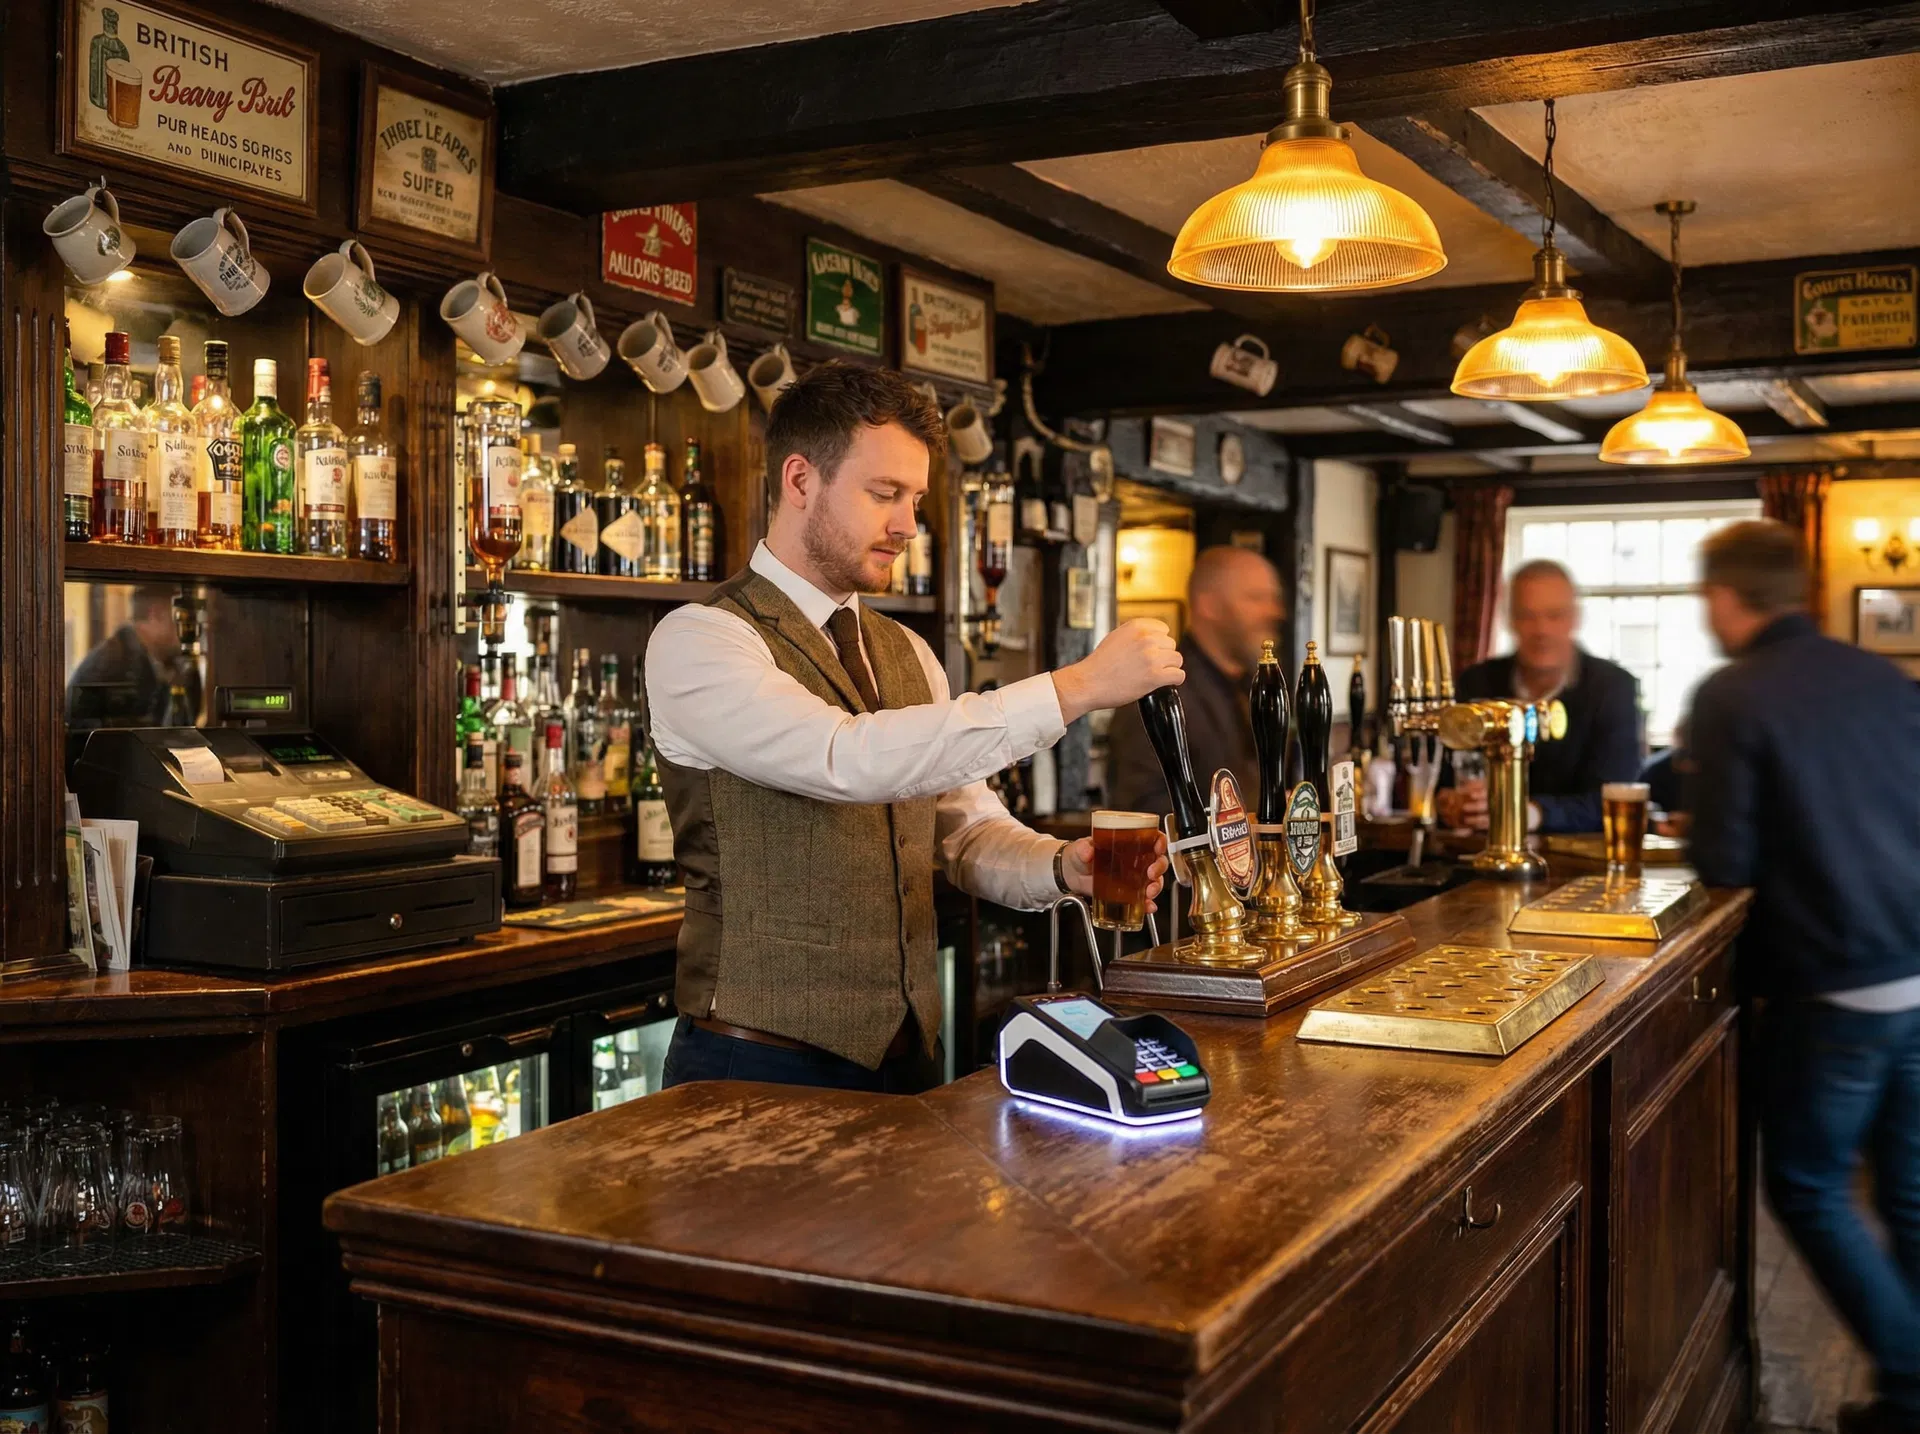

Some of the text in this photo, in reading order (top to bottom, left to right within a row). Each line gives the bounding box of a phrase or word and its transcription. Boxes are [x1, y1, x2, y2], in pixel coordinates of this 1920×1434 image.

[137, 22, 228, 72] BRITISH
[157, 114, 187, 135] PUR
[191, 123, 237, 149] HEADS
[167, 142, 192, 156] AND
